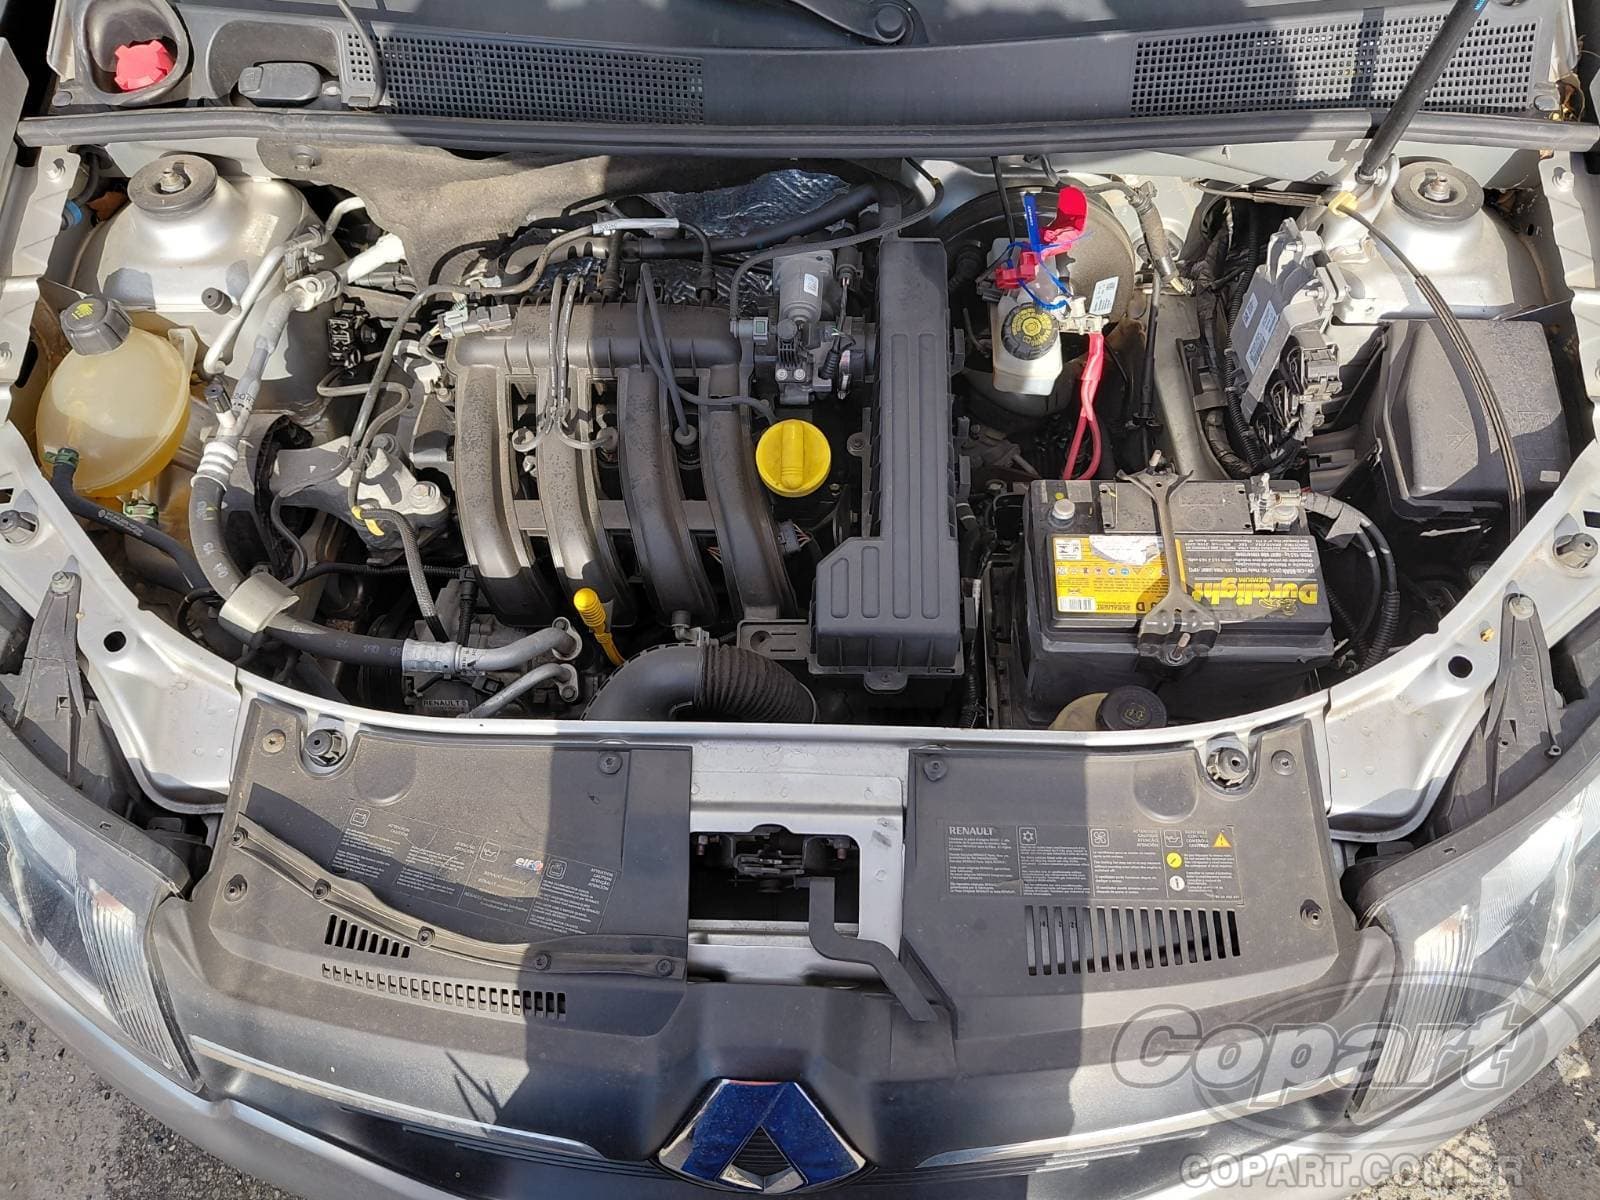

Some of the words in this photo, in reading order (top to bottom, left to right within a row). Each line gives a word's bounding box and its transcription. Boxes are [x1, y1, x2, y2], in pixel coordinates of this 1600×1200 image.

[1192, 577, 1318, 605] Duralight
[948, 826, 993, 836] RENAULT
[515, 857, 540, 872] elf
